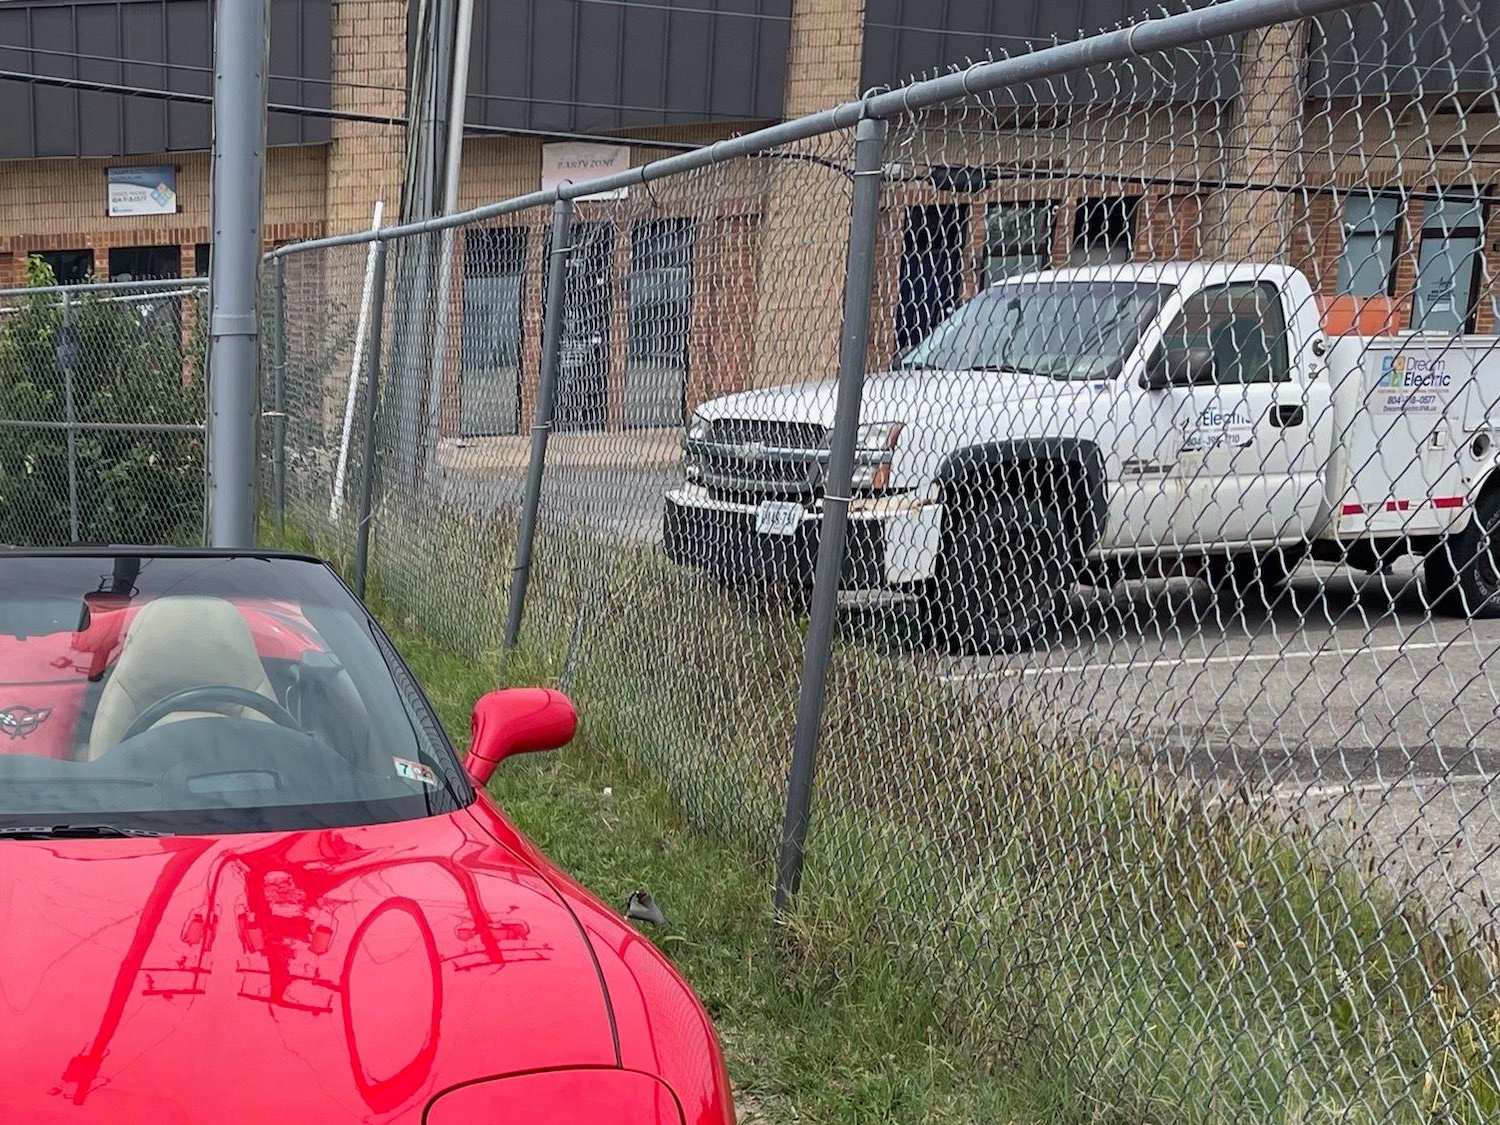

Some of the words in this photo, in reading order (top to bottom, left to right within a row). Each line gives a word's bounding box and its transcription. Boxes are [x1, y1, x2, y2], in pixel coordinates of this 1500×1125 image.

[1406, 356, 1445, 371] Dream
[1404, 371, 1451, 387] Electric
[1203, 411, 1251, 426] Electri
